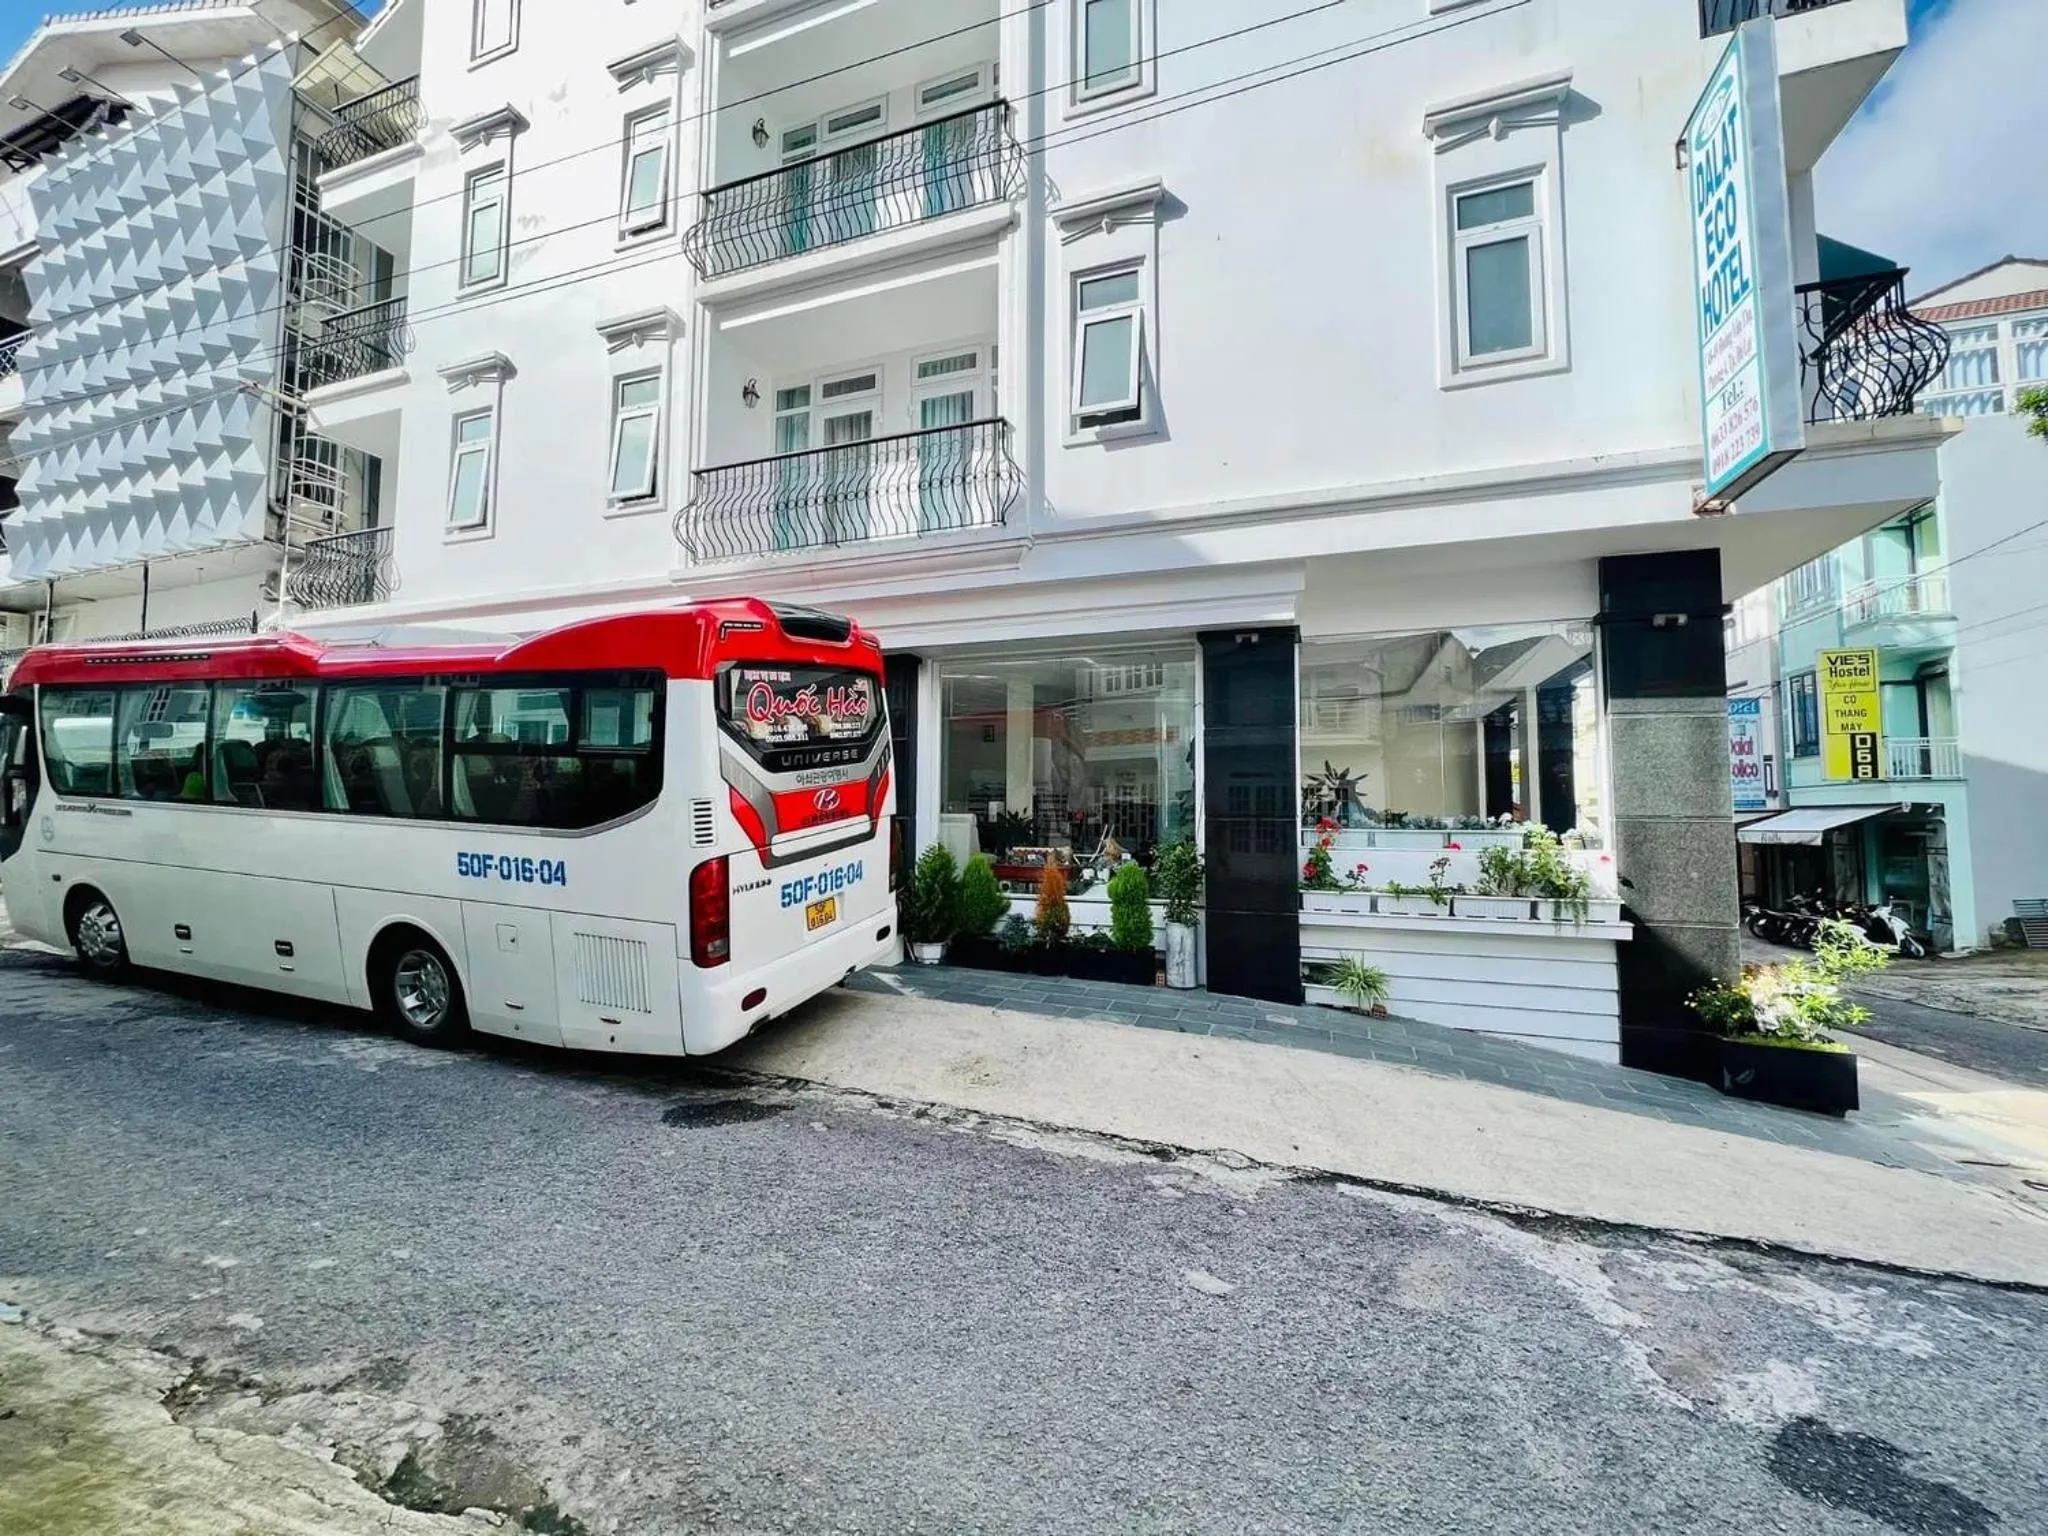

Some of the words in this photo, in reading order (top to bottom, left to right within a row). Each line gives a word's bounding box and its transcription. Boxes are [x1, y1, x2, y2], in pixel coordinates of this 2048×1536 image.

[1695, 102, 1738, 217] DALAT
[1703, 180, 1737, 270] ECO
[1701, 239, 1750, 339] HOTEL
[746, 682, 822, 723] Quốc
[1829, 665, 1870, 678] Hostel
[781, 748, 859, 767] UNIVERSE
